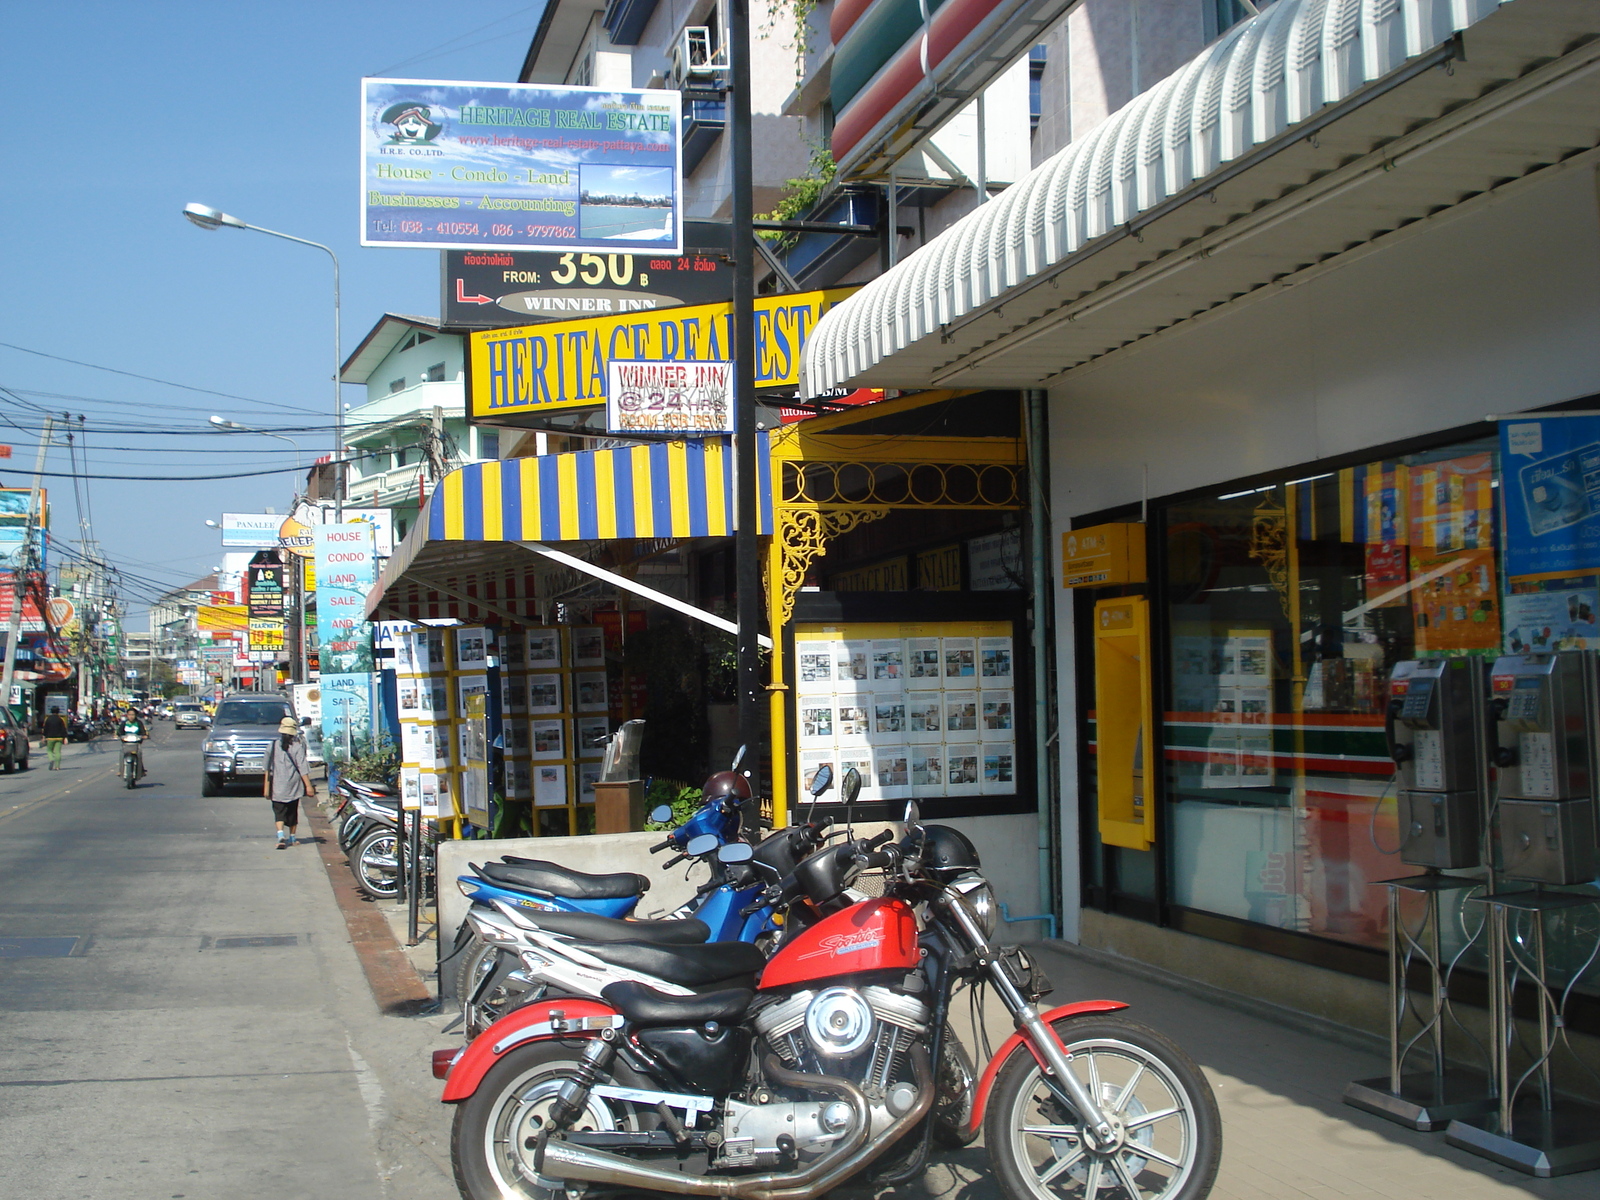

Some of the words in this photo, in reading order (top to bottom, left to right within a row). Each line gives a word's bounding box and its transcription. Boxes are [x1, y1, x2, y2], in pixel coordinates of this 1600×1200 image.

[459, 105, 552, 128] HERITAGE
[555, 109, 602, 130] REAL
[606, 112, 671, 132] ESTATE
[459, 134, 671, 155] www.heritage-real-estate-pattaya.com
[377, 163, 432, 180] House
[452, 165, 508, 182] Condo
[528, 168, 570, 185] Land
[369, 190, 460, 210] Businesses
[478, 195, 576, 217] Accounting
[373, 219, 397, 234] Tel:
[401, 221, 423, 234] 038
[550, 252, 635, 286] 350
[677, 258, 690, 271] 24
[503, 270, 541, 284] FROM:
[523, 296, 612, 311] WINNER
[618, 298, 657, 312] INN
[617, 365, 688, 388] WINNER
[695, 366, 725, 389] INN
[648, 392, 684, 411] 24
[237, 521, 276, 529] PANALEE
[327, 531, 362, 542] HOUSE
[1081, 536, 1097, 550] ATM
[327, 552, 365, 563] CONDO
[329, 574, 357, 584] LAND
[330, 596, 356, 606] SALE
[331, 619, 353, 629] AND
[331, 641, 358, 651] RENT
[331, 678, 355, 687] LAND
[332, 697, 354, 706] SAE
